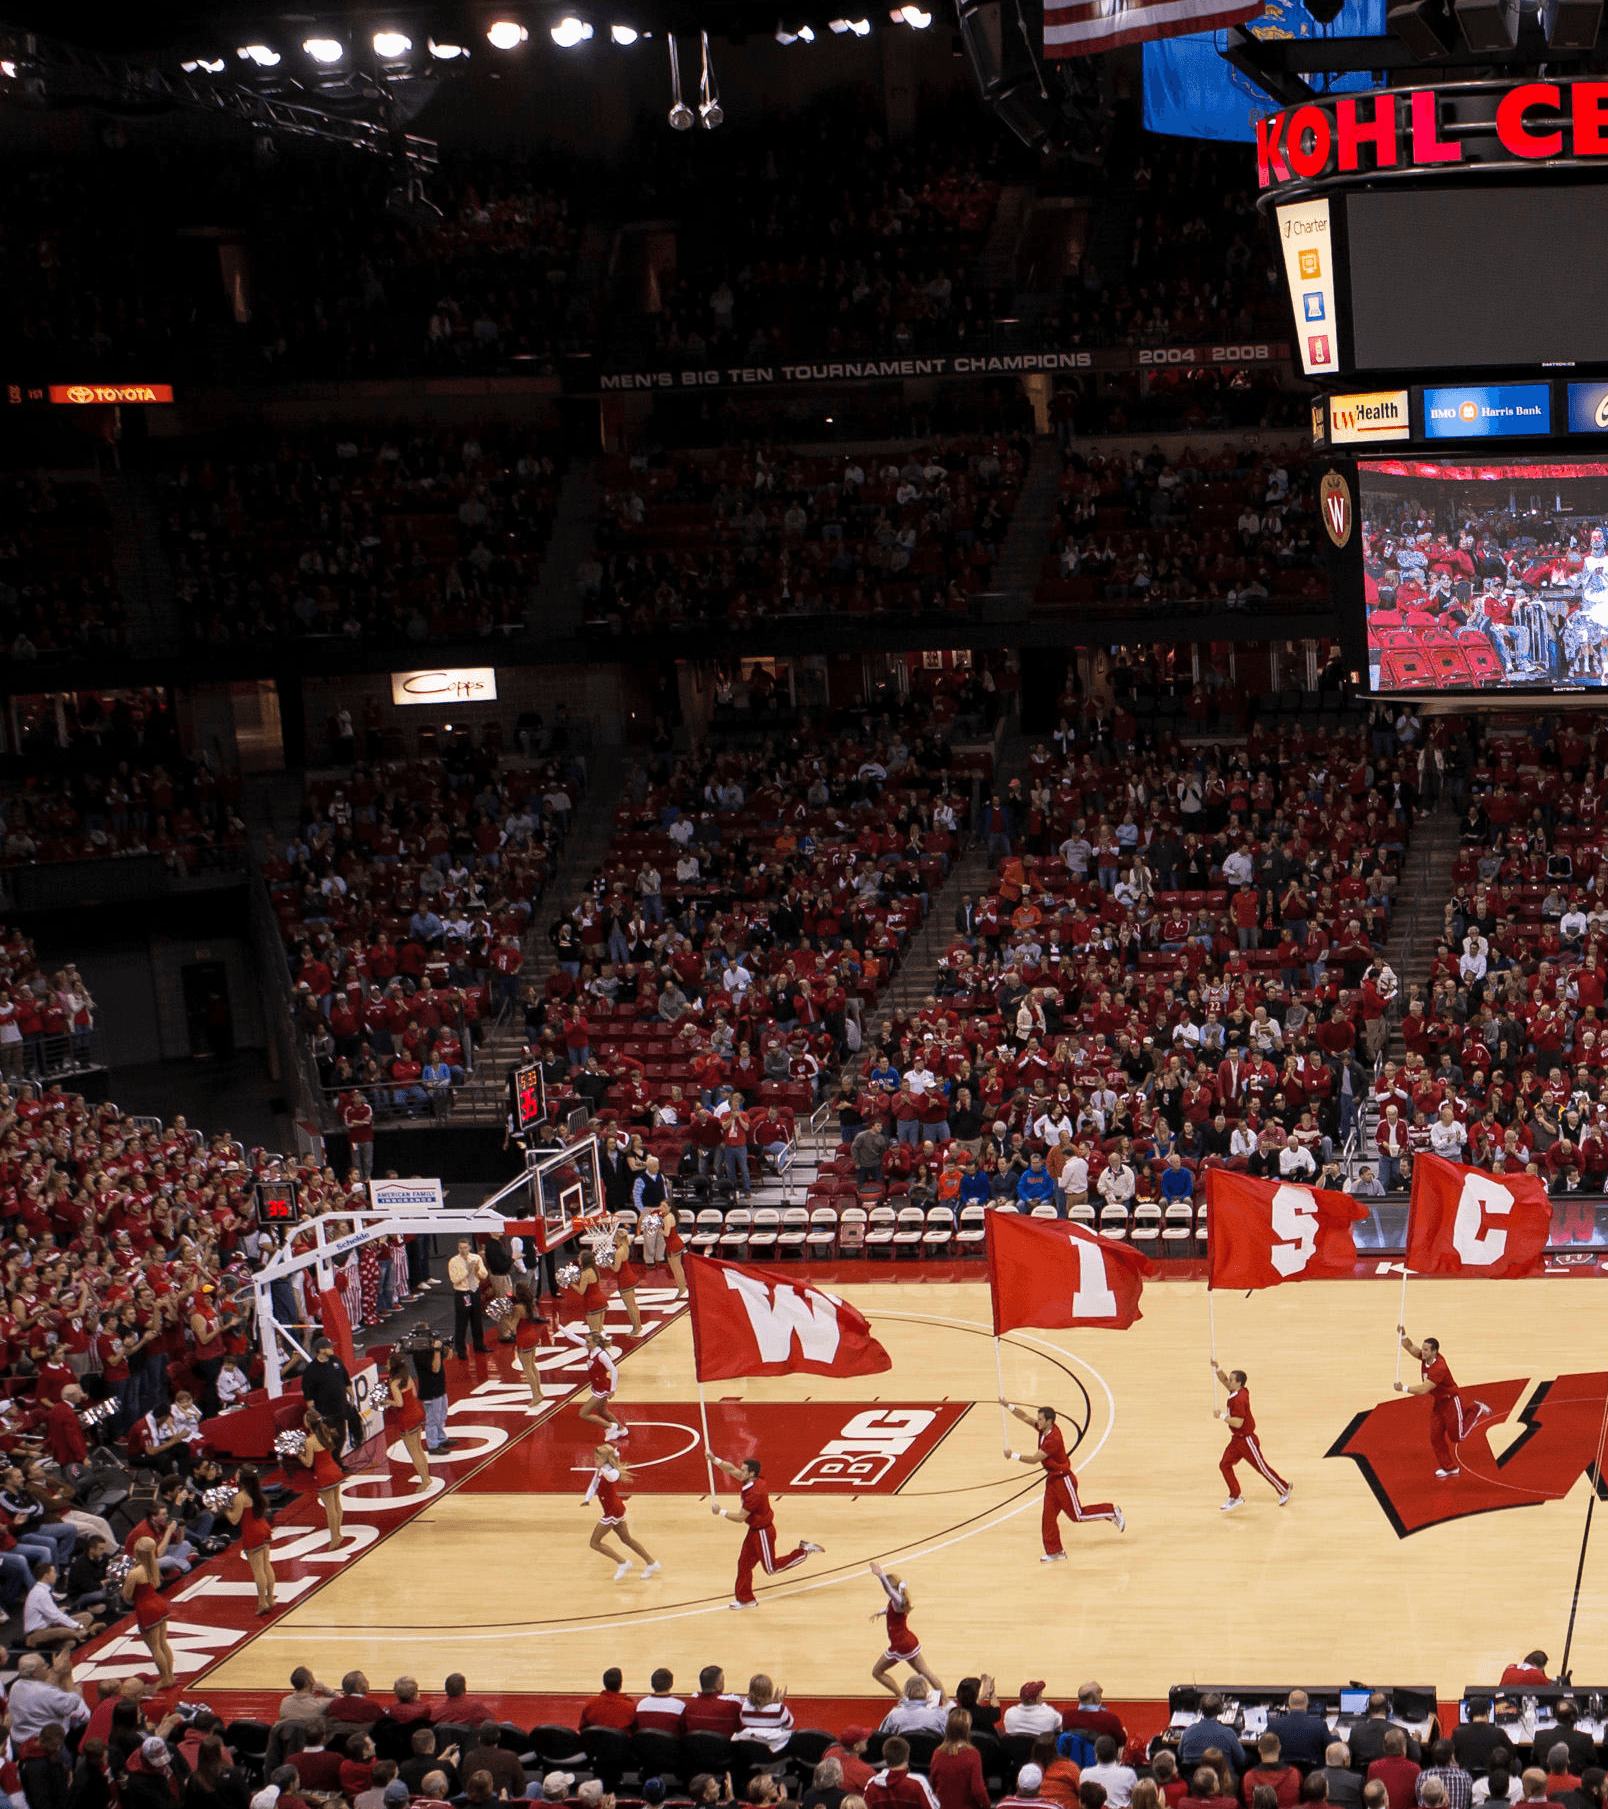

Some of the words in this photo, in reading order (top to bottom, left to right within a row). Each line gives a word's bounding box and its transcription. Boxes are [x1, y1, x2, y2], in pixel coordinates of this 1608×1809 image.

[1257, 91, 1461, 188] KOHL
[1293, 220, 1328, 235] Charter
[601, 373, 672, 389] MEN'S
[681, 370, 720, 386] BIG
[727, 367, 774, 384] TEN
[781, 359, 946, 380] TOURNAMENT
[954, 352, 1092, 372] CHAMPIONS
[1139, 349, 1196, 364] 2004
[1212, 345, 1268, 361] 2008
[95, 388, 157, 401] TOYOTA
[1333, 411, 1357, 430] UW
[1357, 402, 1399, 421] Health
[1431, 408, 1456, 419] BMO
[1481, 406, 1514, 417] Harris
[1516, 405, 1542, 416] Bank
[1327, 496, 1345, 535] W
[403, 673, 484, 697] Copps
[268, 1201, 287, 1216] 35
[1453, 1173, 1515, 1265] C
[336, 1233, 369, 1250] Schelde
[1270, 1183, 1320, 1277] S
[722, 1268, 843, 1363] W
[72, 1287, 691, 1683] WISCONSIN
